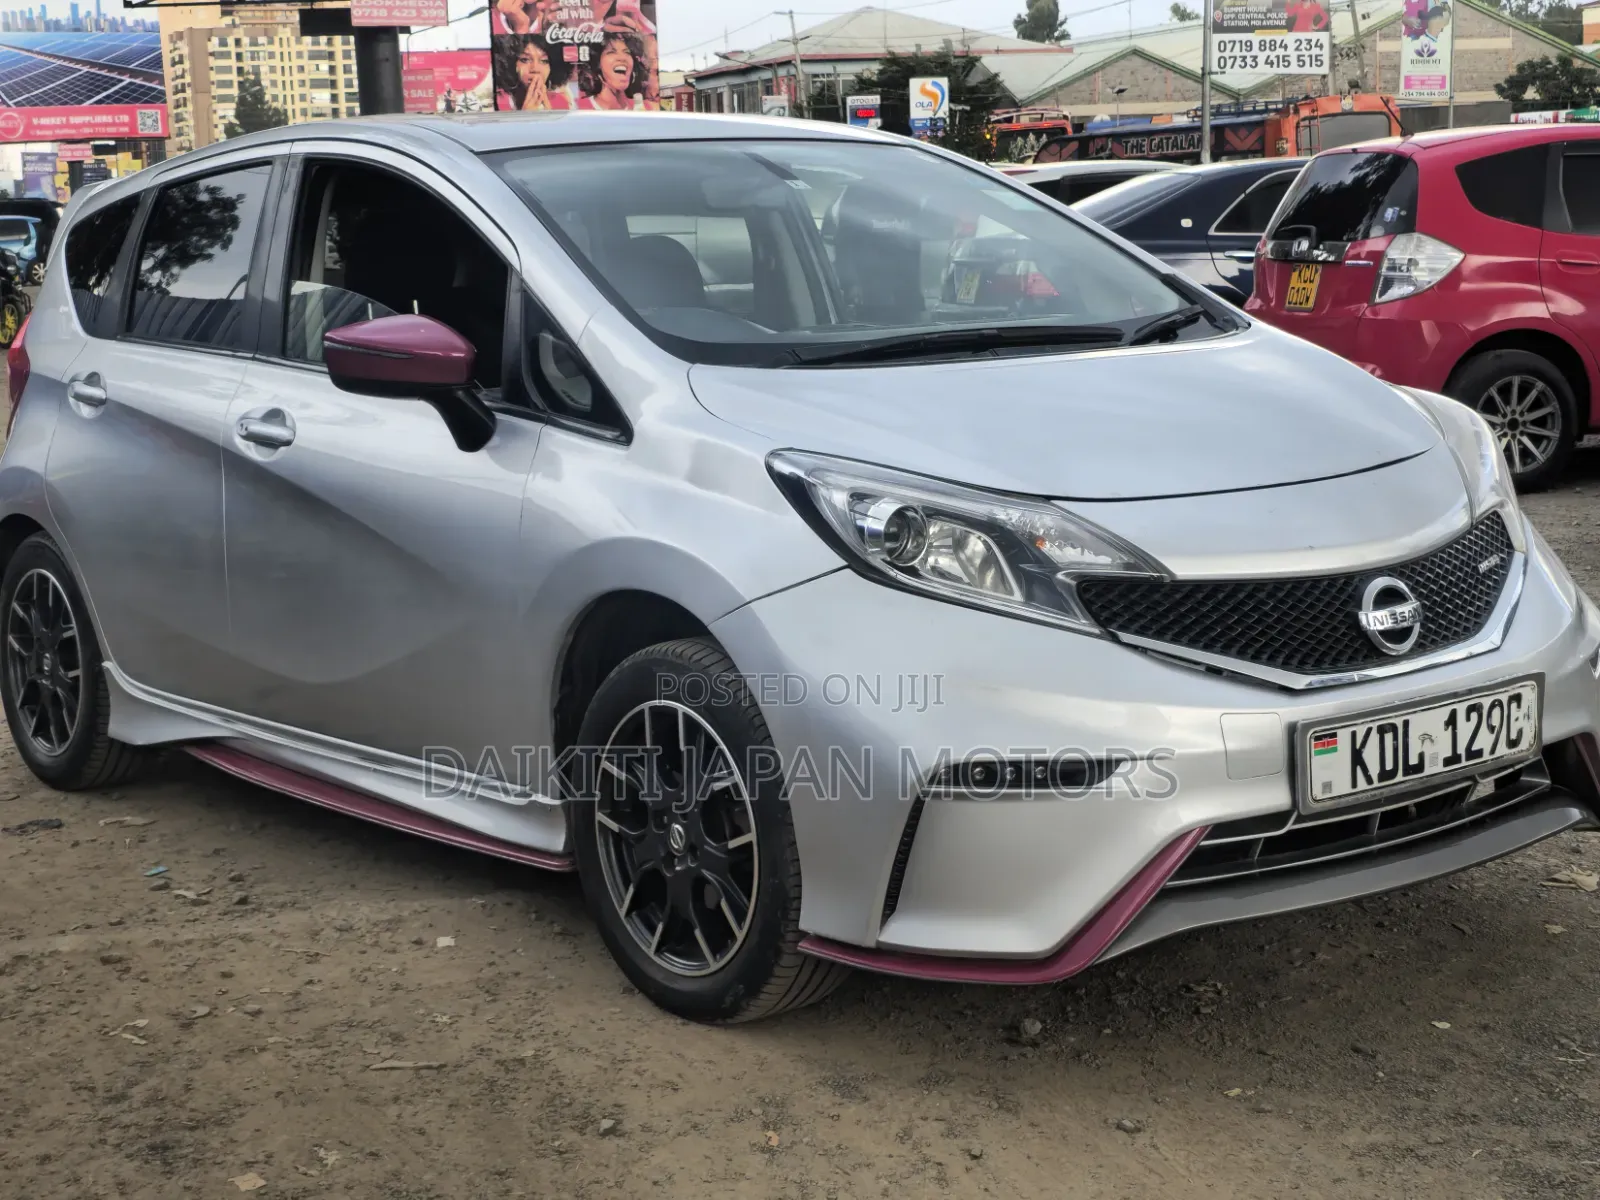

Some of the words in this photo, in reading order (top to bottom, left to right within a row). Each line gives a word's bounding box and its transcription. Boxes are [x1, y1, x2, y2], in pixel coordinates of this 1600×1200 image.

[557, 8, 568, 19] all
[570, 7, 593, 19] with
[1217, 40, 1253, 53] 0719
[1258, 39, 1288, 52] 884
[1294, 38, 1324, 51] 234
[1217, 55, 1258, 69] 0733
[1264, 54, 1291, 68] 415
[1297, 54, 1324, 67] 515
[410, 88, 435, 98] SALE
[69, 114, 113, 123] SUPPLIERS
[115, 113, 130, 123] LTD
[1122, 137, 1148, 156] THE
[1372, 605, 1422, 627] NISSAN
[1350, 718, 1425, 789] KDL
[1442, 691, 1524, 768] 129C
